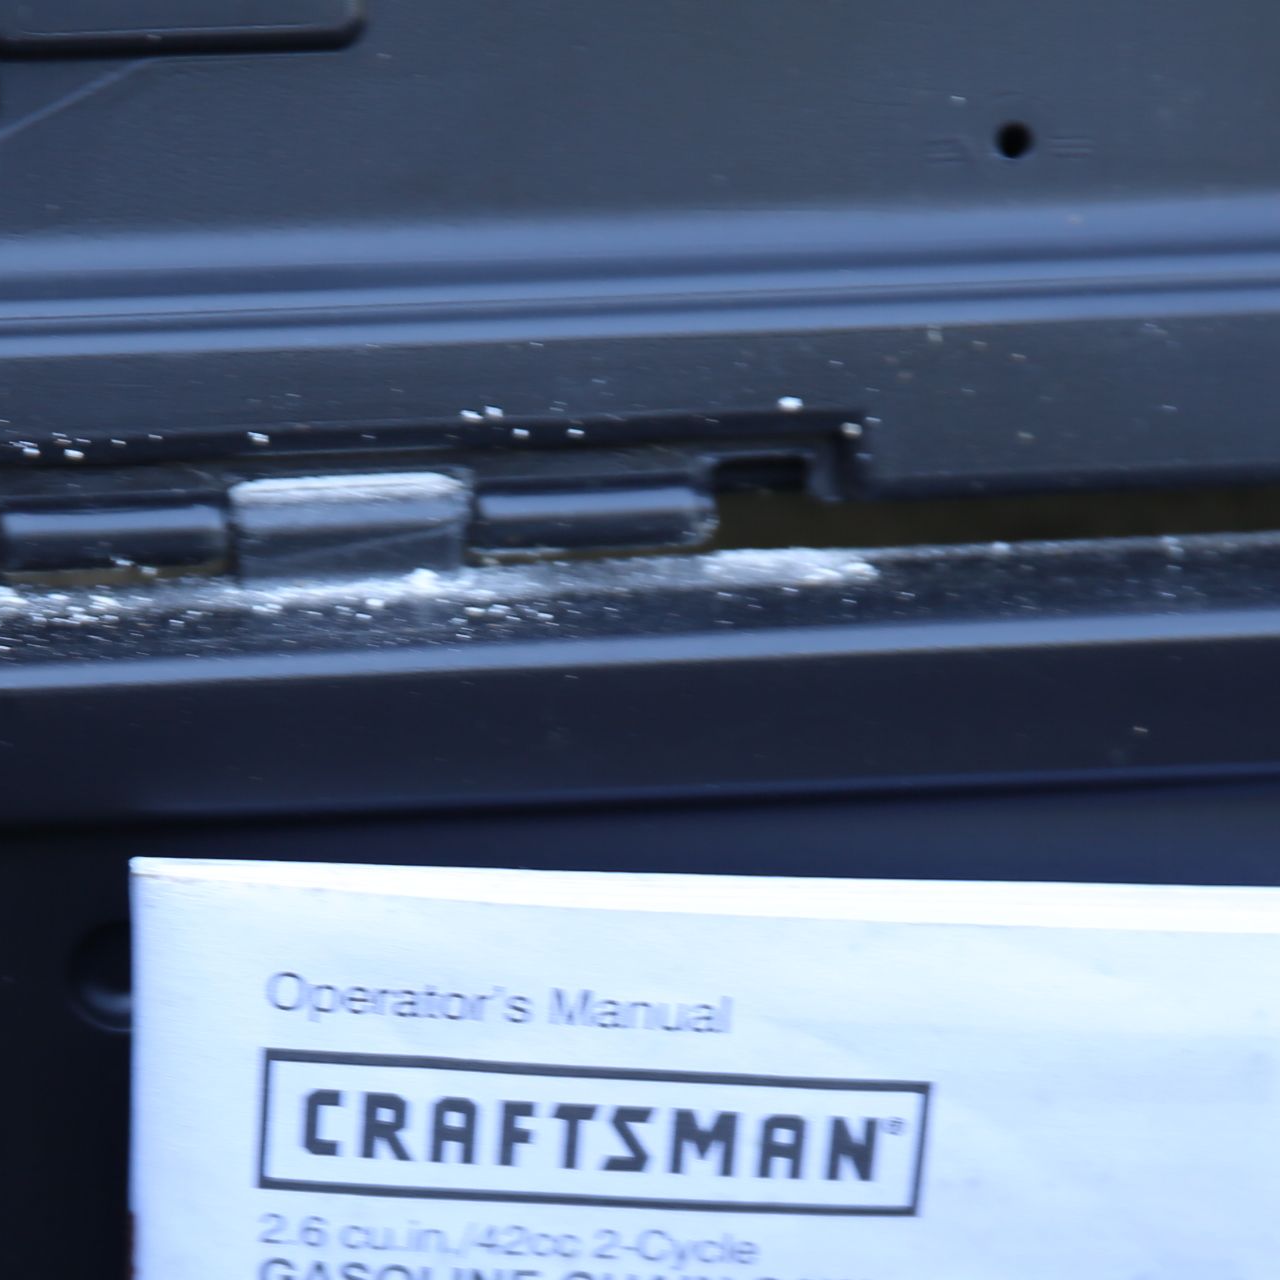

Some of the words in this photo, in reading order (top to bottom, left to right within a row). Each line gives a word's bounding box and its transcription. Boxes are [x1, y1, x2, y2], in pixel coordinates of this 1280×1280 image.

[265, 970, 534, 1024] Operator's
[547, 986, 735, 1034] Manual
[300, 1087, 882, 1183] CRAFTSMAN
[256, 1212, 328, 1249] 2.6
[592, 1228, 761, 1270] 2-Cycle
